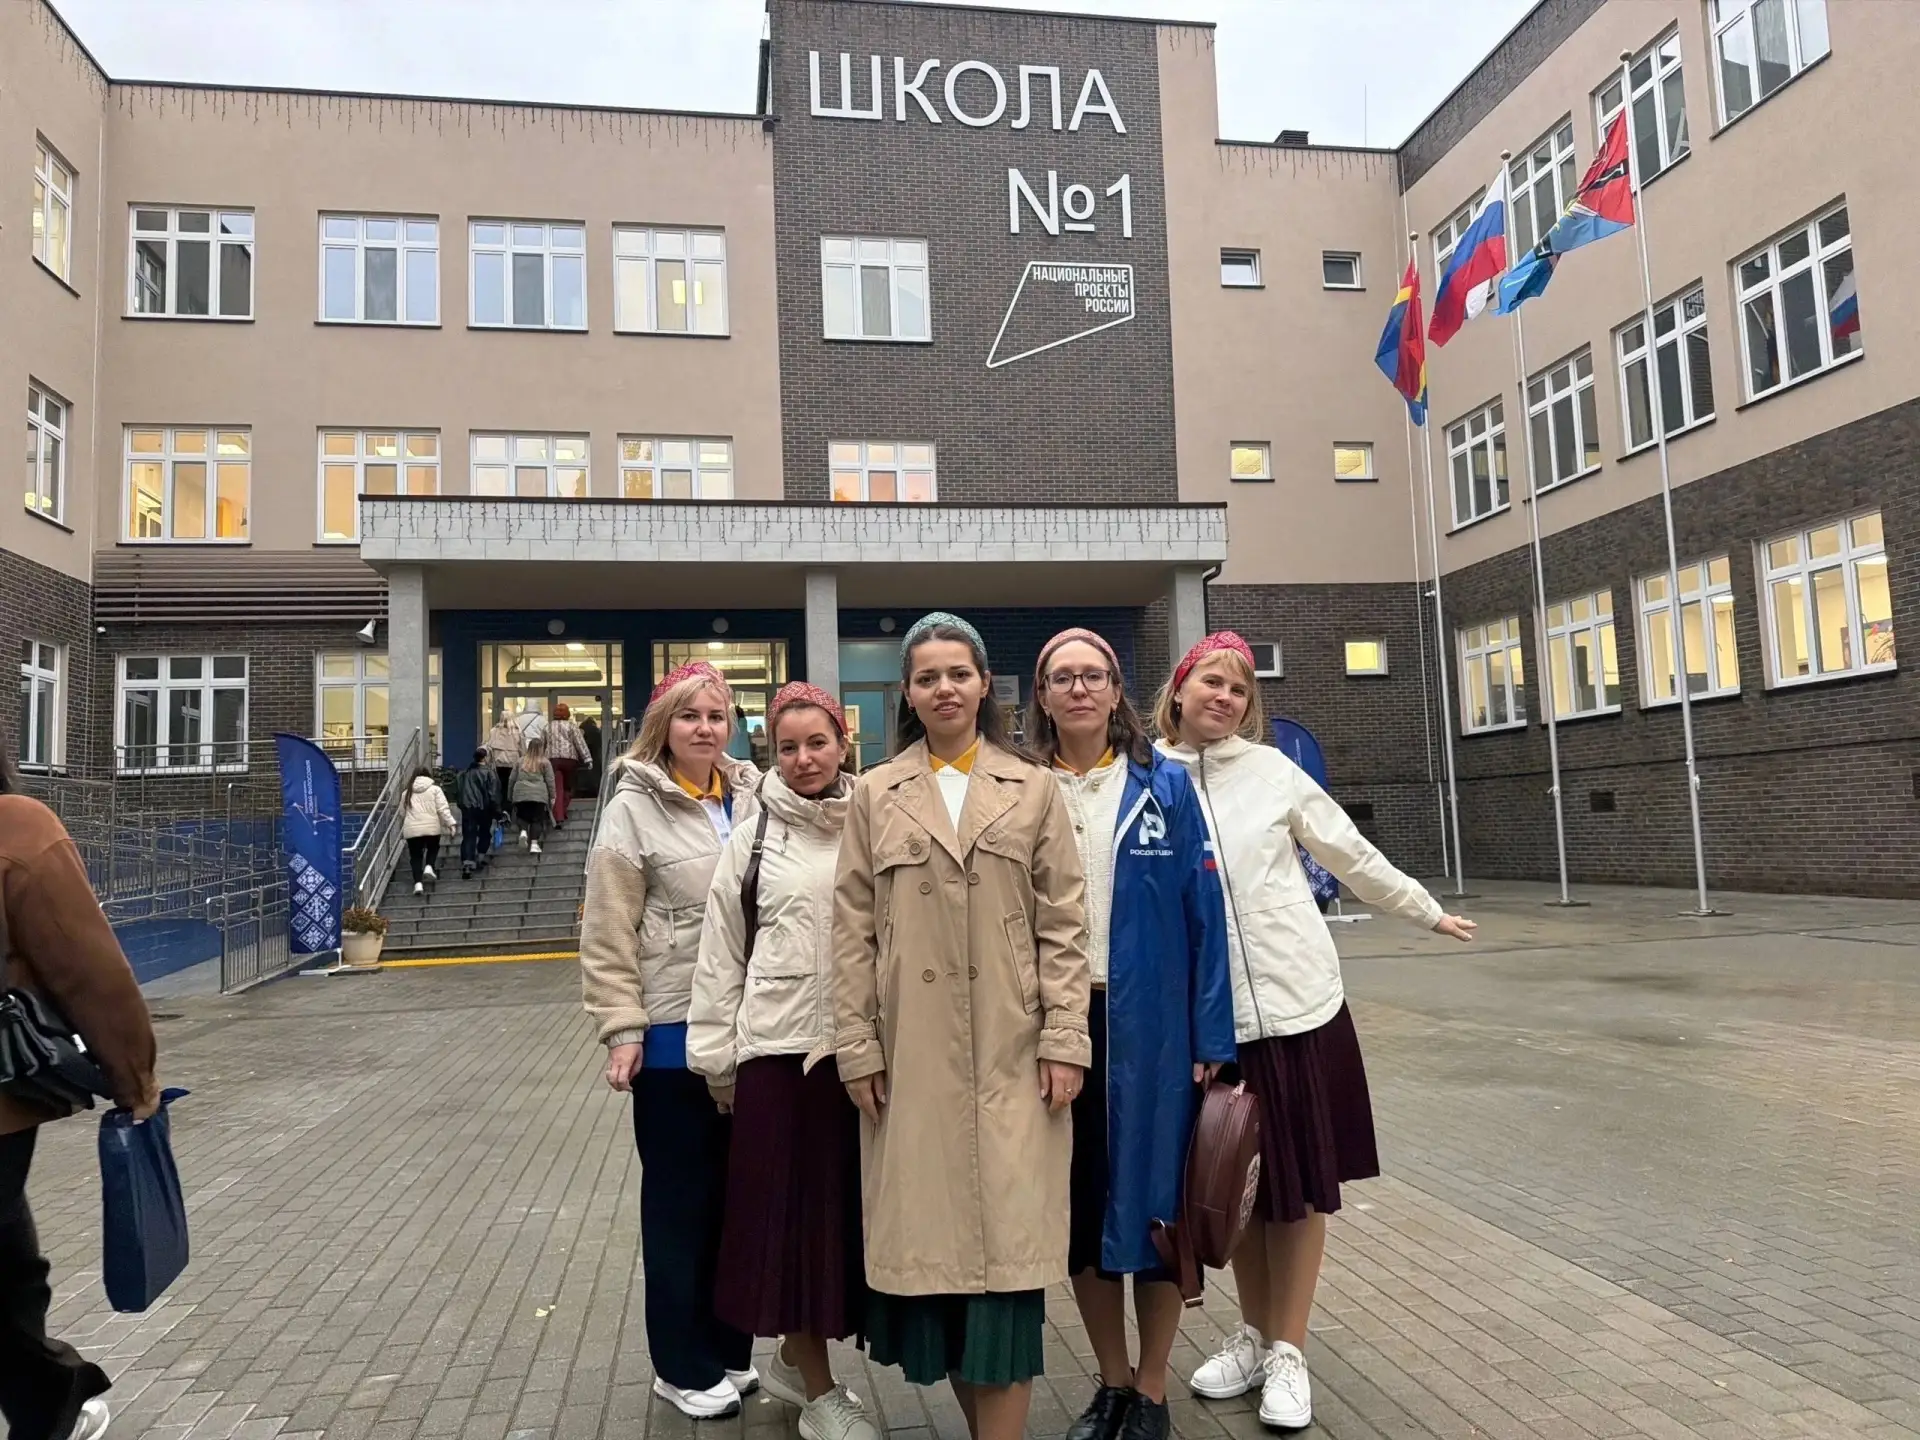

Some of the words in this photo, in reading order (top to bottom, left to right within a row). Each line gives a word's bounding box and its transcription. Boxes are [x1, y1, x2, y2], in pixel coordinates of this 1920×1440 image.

[809, 50, 1127, 133] ШКОЛА
[1032, 266, 1129, 283] НАЦИОНАЛЬНЫЕ
[1074, 282, 1129, 298] ПРОЕКТЫ
[1085, 298, 1129, 313] РОССИИ
